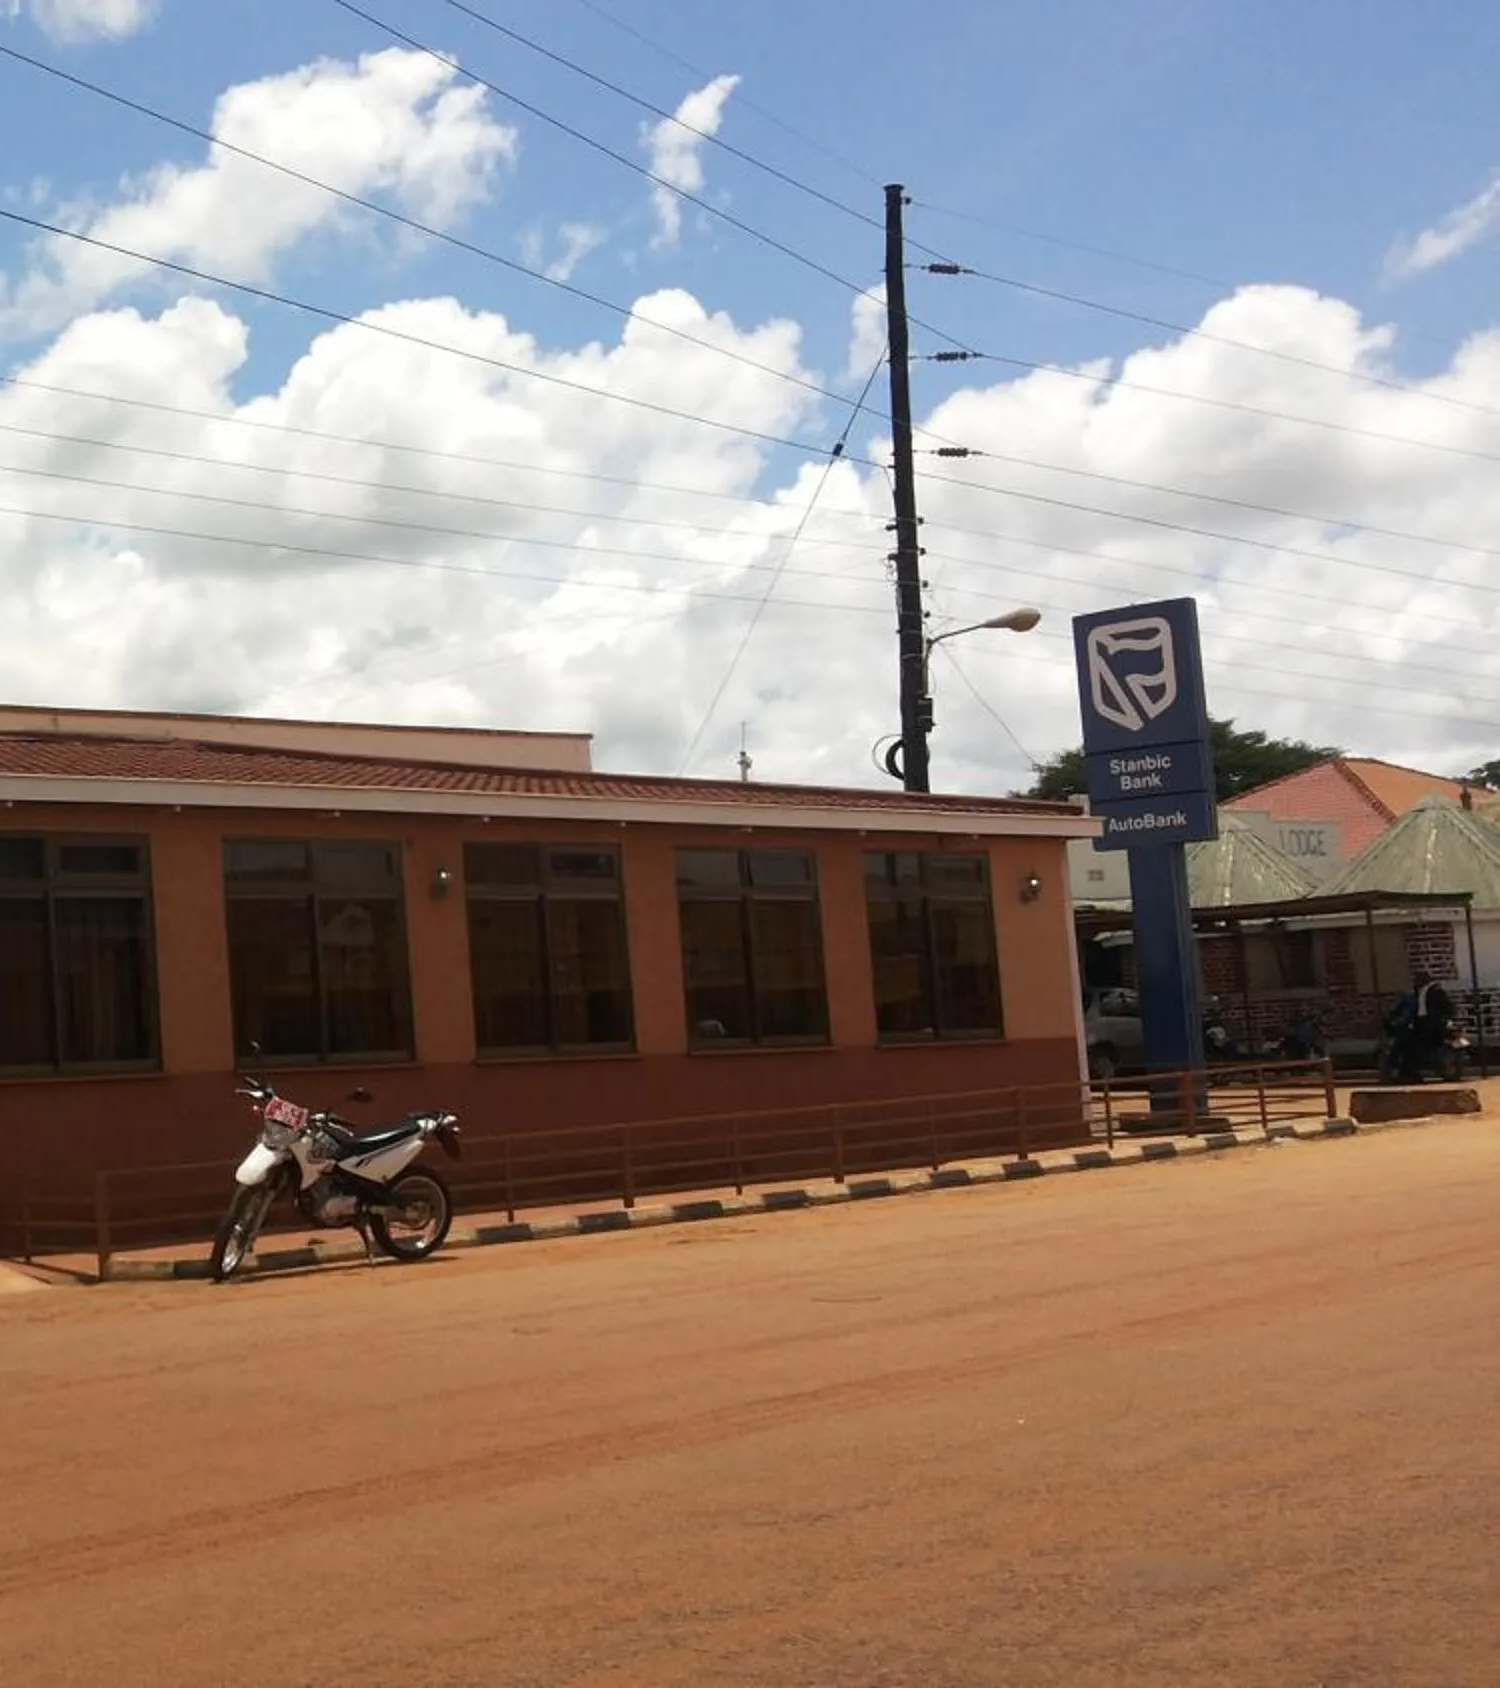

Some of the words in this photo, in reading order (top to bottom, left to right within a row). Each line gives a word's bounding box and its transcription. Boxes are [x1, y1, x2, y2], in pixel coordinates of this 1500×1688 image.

[1109, 754, 1172, 775] Stanbic
[1120, 773, 1163, 791] Bank
[1108, 811, 1187, 833] AutoBank
[1278, 828, 1327, 857] LODGE
